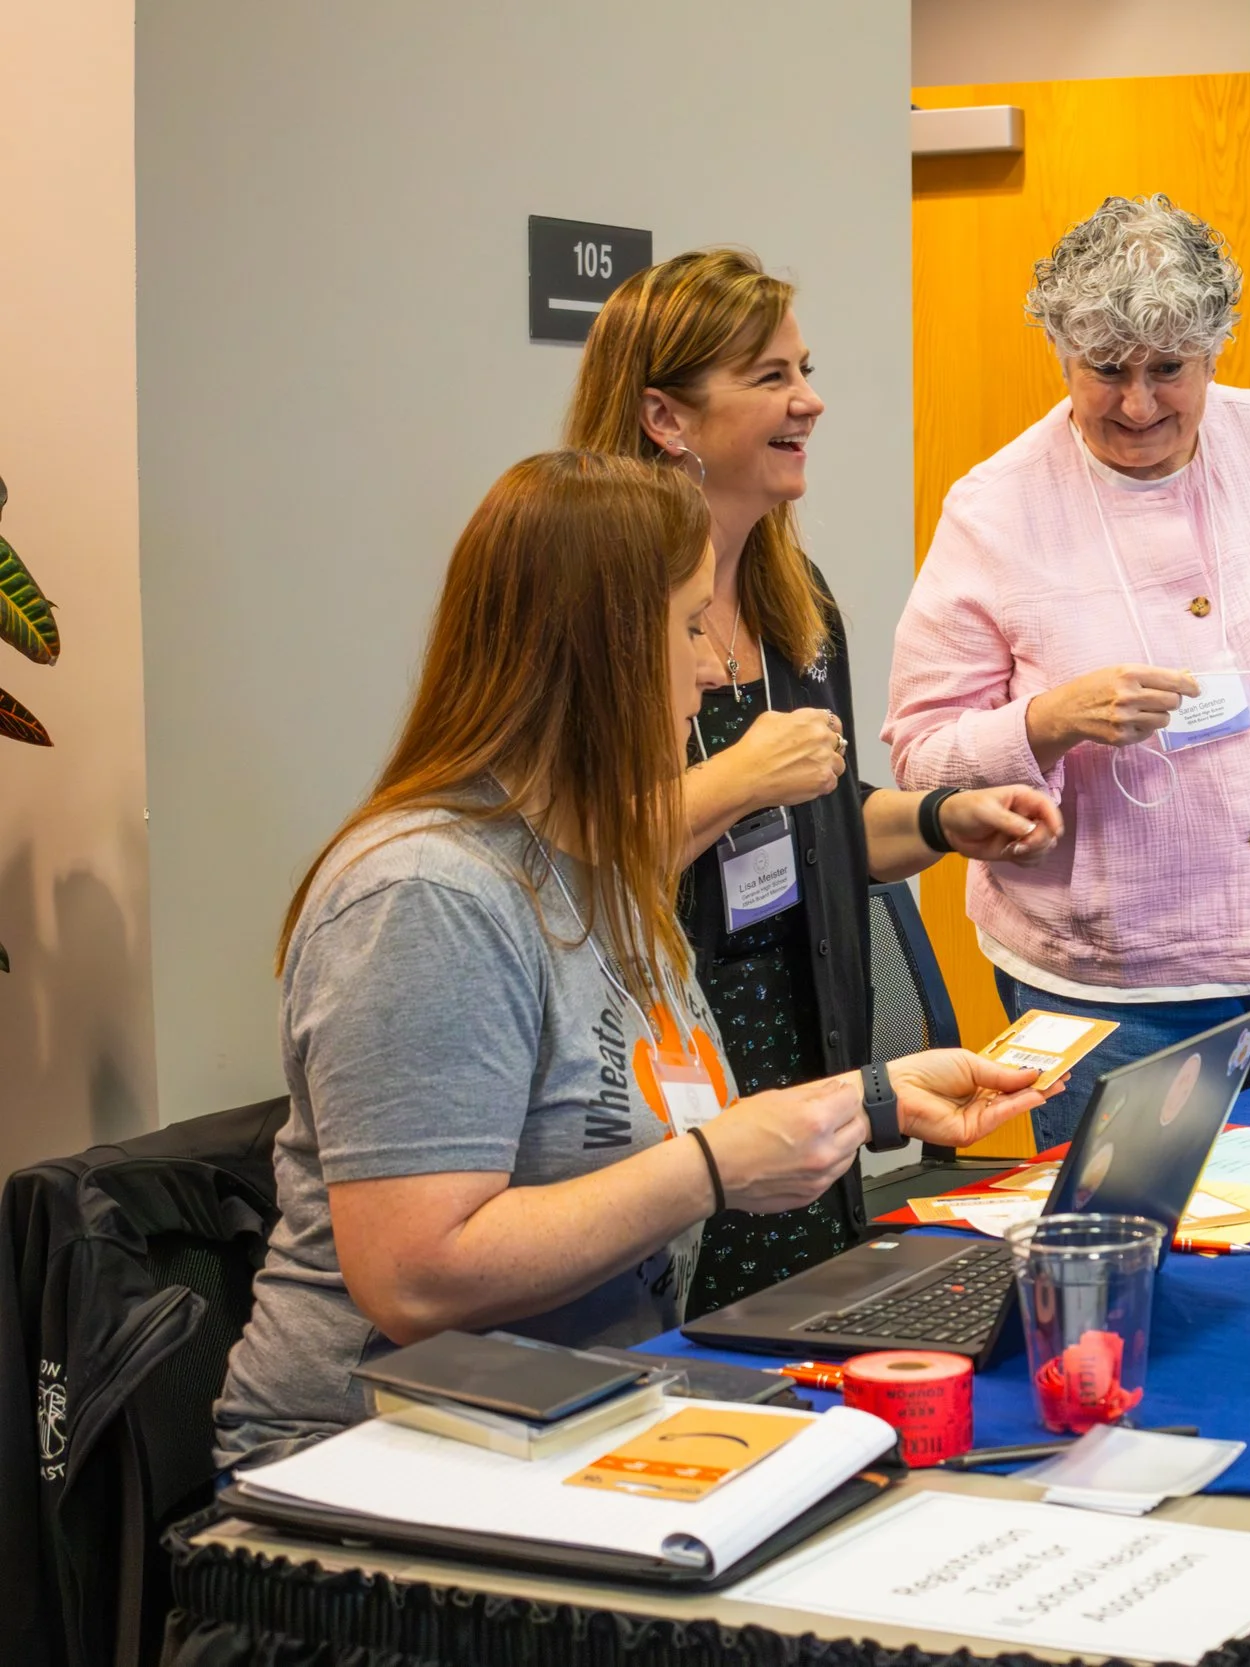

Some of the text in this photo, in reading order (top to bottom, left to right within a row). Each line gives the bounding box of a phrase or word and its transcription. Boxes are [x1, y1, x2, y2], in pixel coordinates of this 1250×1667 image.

[573, 241, 613, 279] 105
[738, 879, 757, 893] Lisa
[757, 866, 788, 885] Meister
[1079, 1356, 1097, 1408] TICKET
[892, 1528, 1034, 1597] Registration
[963, 1562, 1042, 1596] Table
[1017, 1562, 1103, 1615] School
[1080, 1552, 1210, 1624] Association
